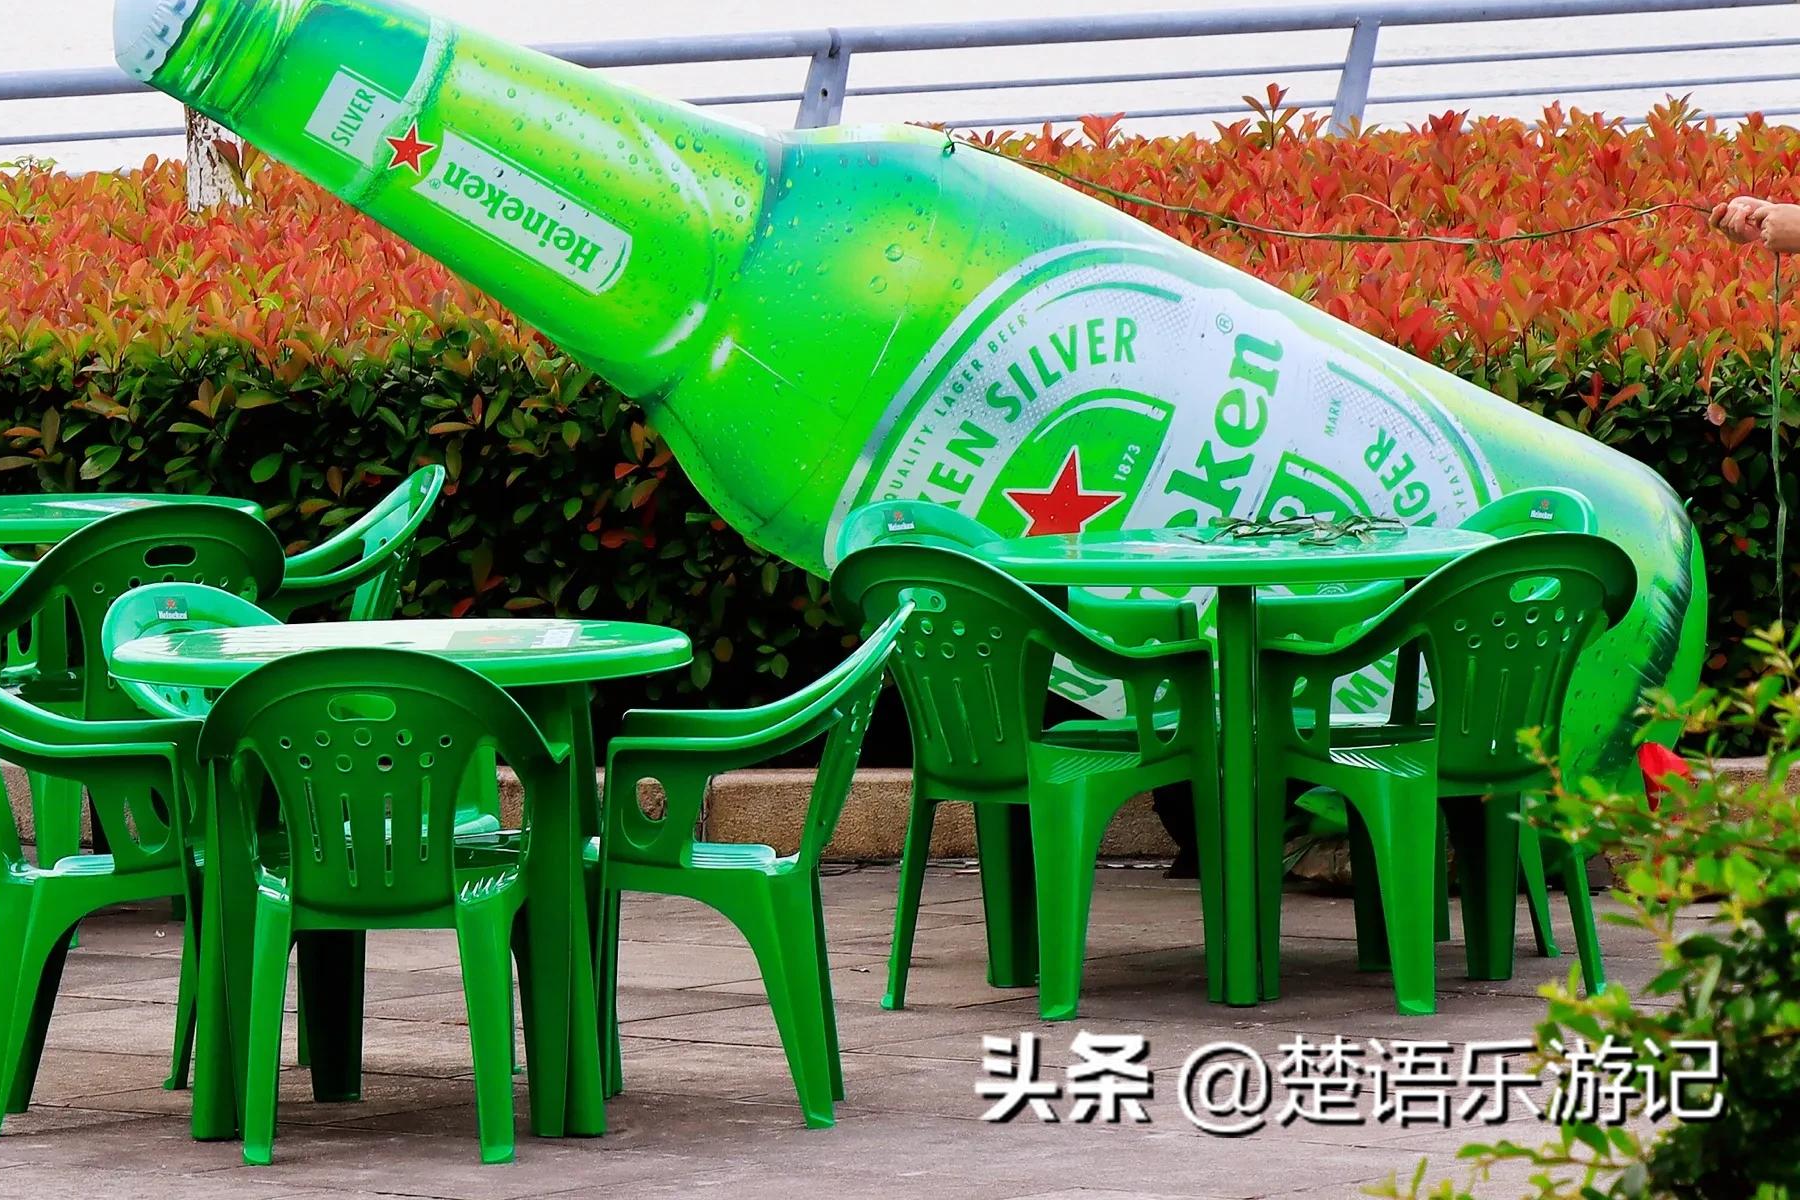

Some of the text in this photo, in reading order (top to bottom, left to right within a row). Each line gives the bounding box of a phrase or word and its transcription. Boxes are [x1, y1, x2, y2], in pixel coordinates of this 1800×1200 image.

[330, 87, 377, 148] SILVER
[441, 161, 604, 274] Heineken
[985, 317, 1138, 424] SILVER
[883, 313, 1029, 501] QUALITY LAGER BEER
[1323, 397, 1342, 439] MARK
[1114, 443, 1141, 483] 1873
[887, 521, 915, 532] Heineken
[157, 610, 188, 621] Heineken
